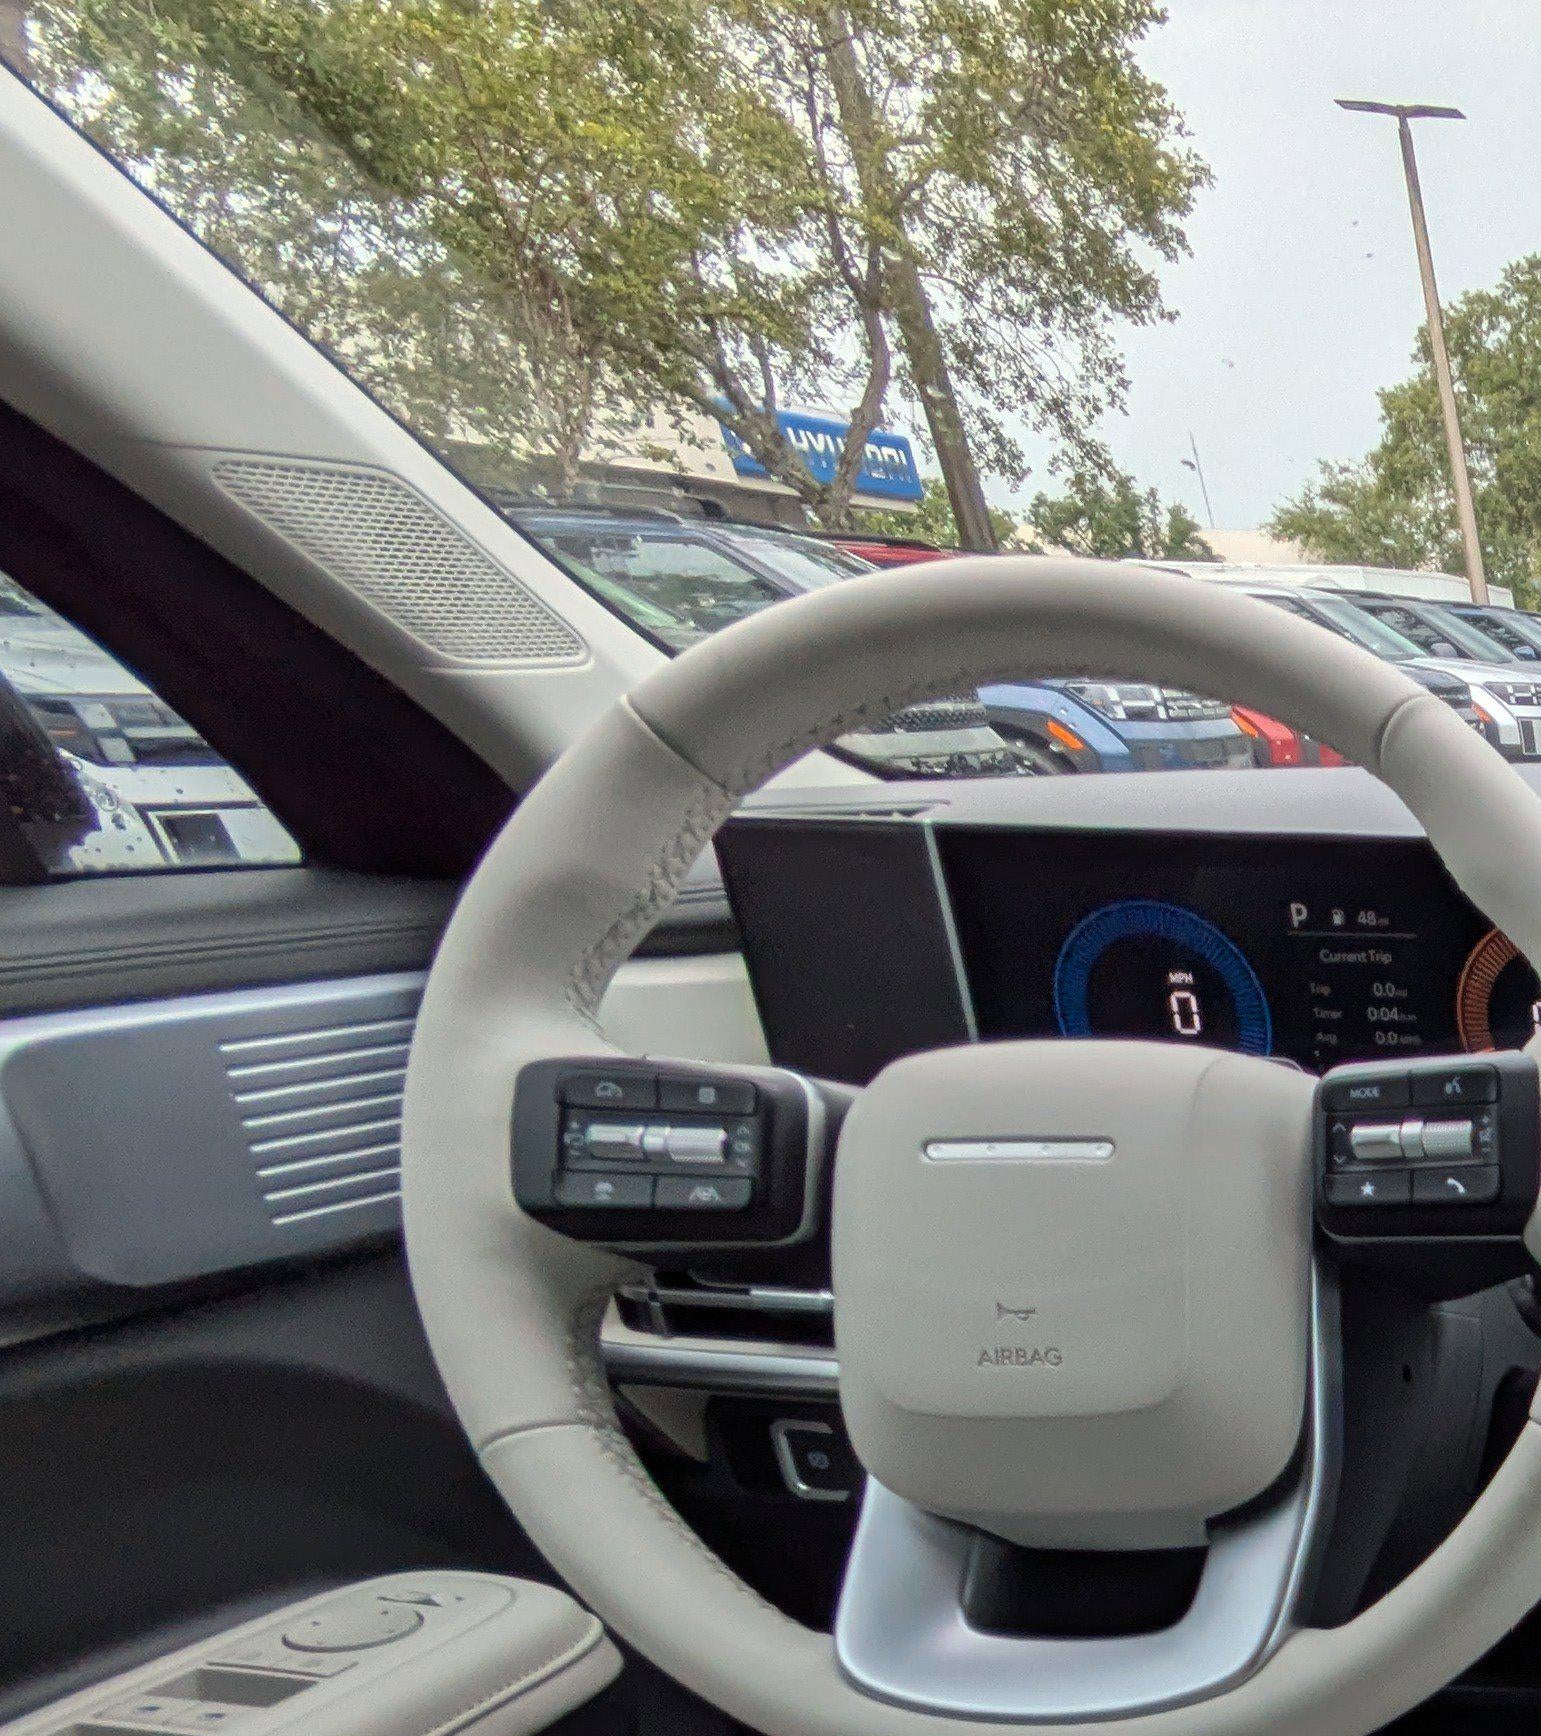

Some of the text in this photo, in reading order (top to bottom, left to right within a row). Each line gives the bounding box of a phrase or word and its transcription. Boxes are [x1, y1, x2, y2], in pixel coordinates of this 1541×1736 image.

[1290, 902, 1307, 928] P
[1319, 949, 1393, 965] Current Trip
[1170, 991, 1202, 1035] 0
[978, 1346, 1063, 1367] AIRBAG
